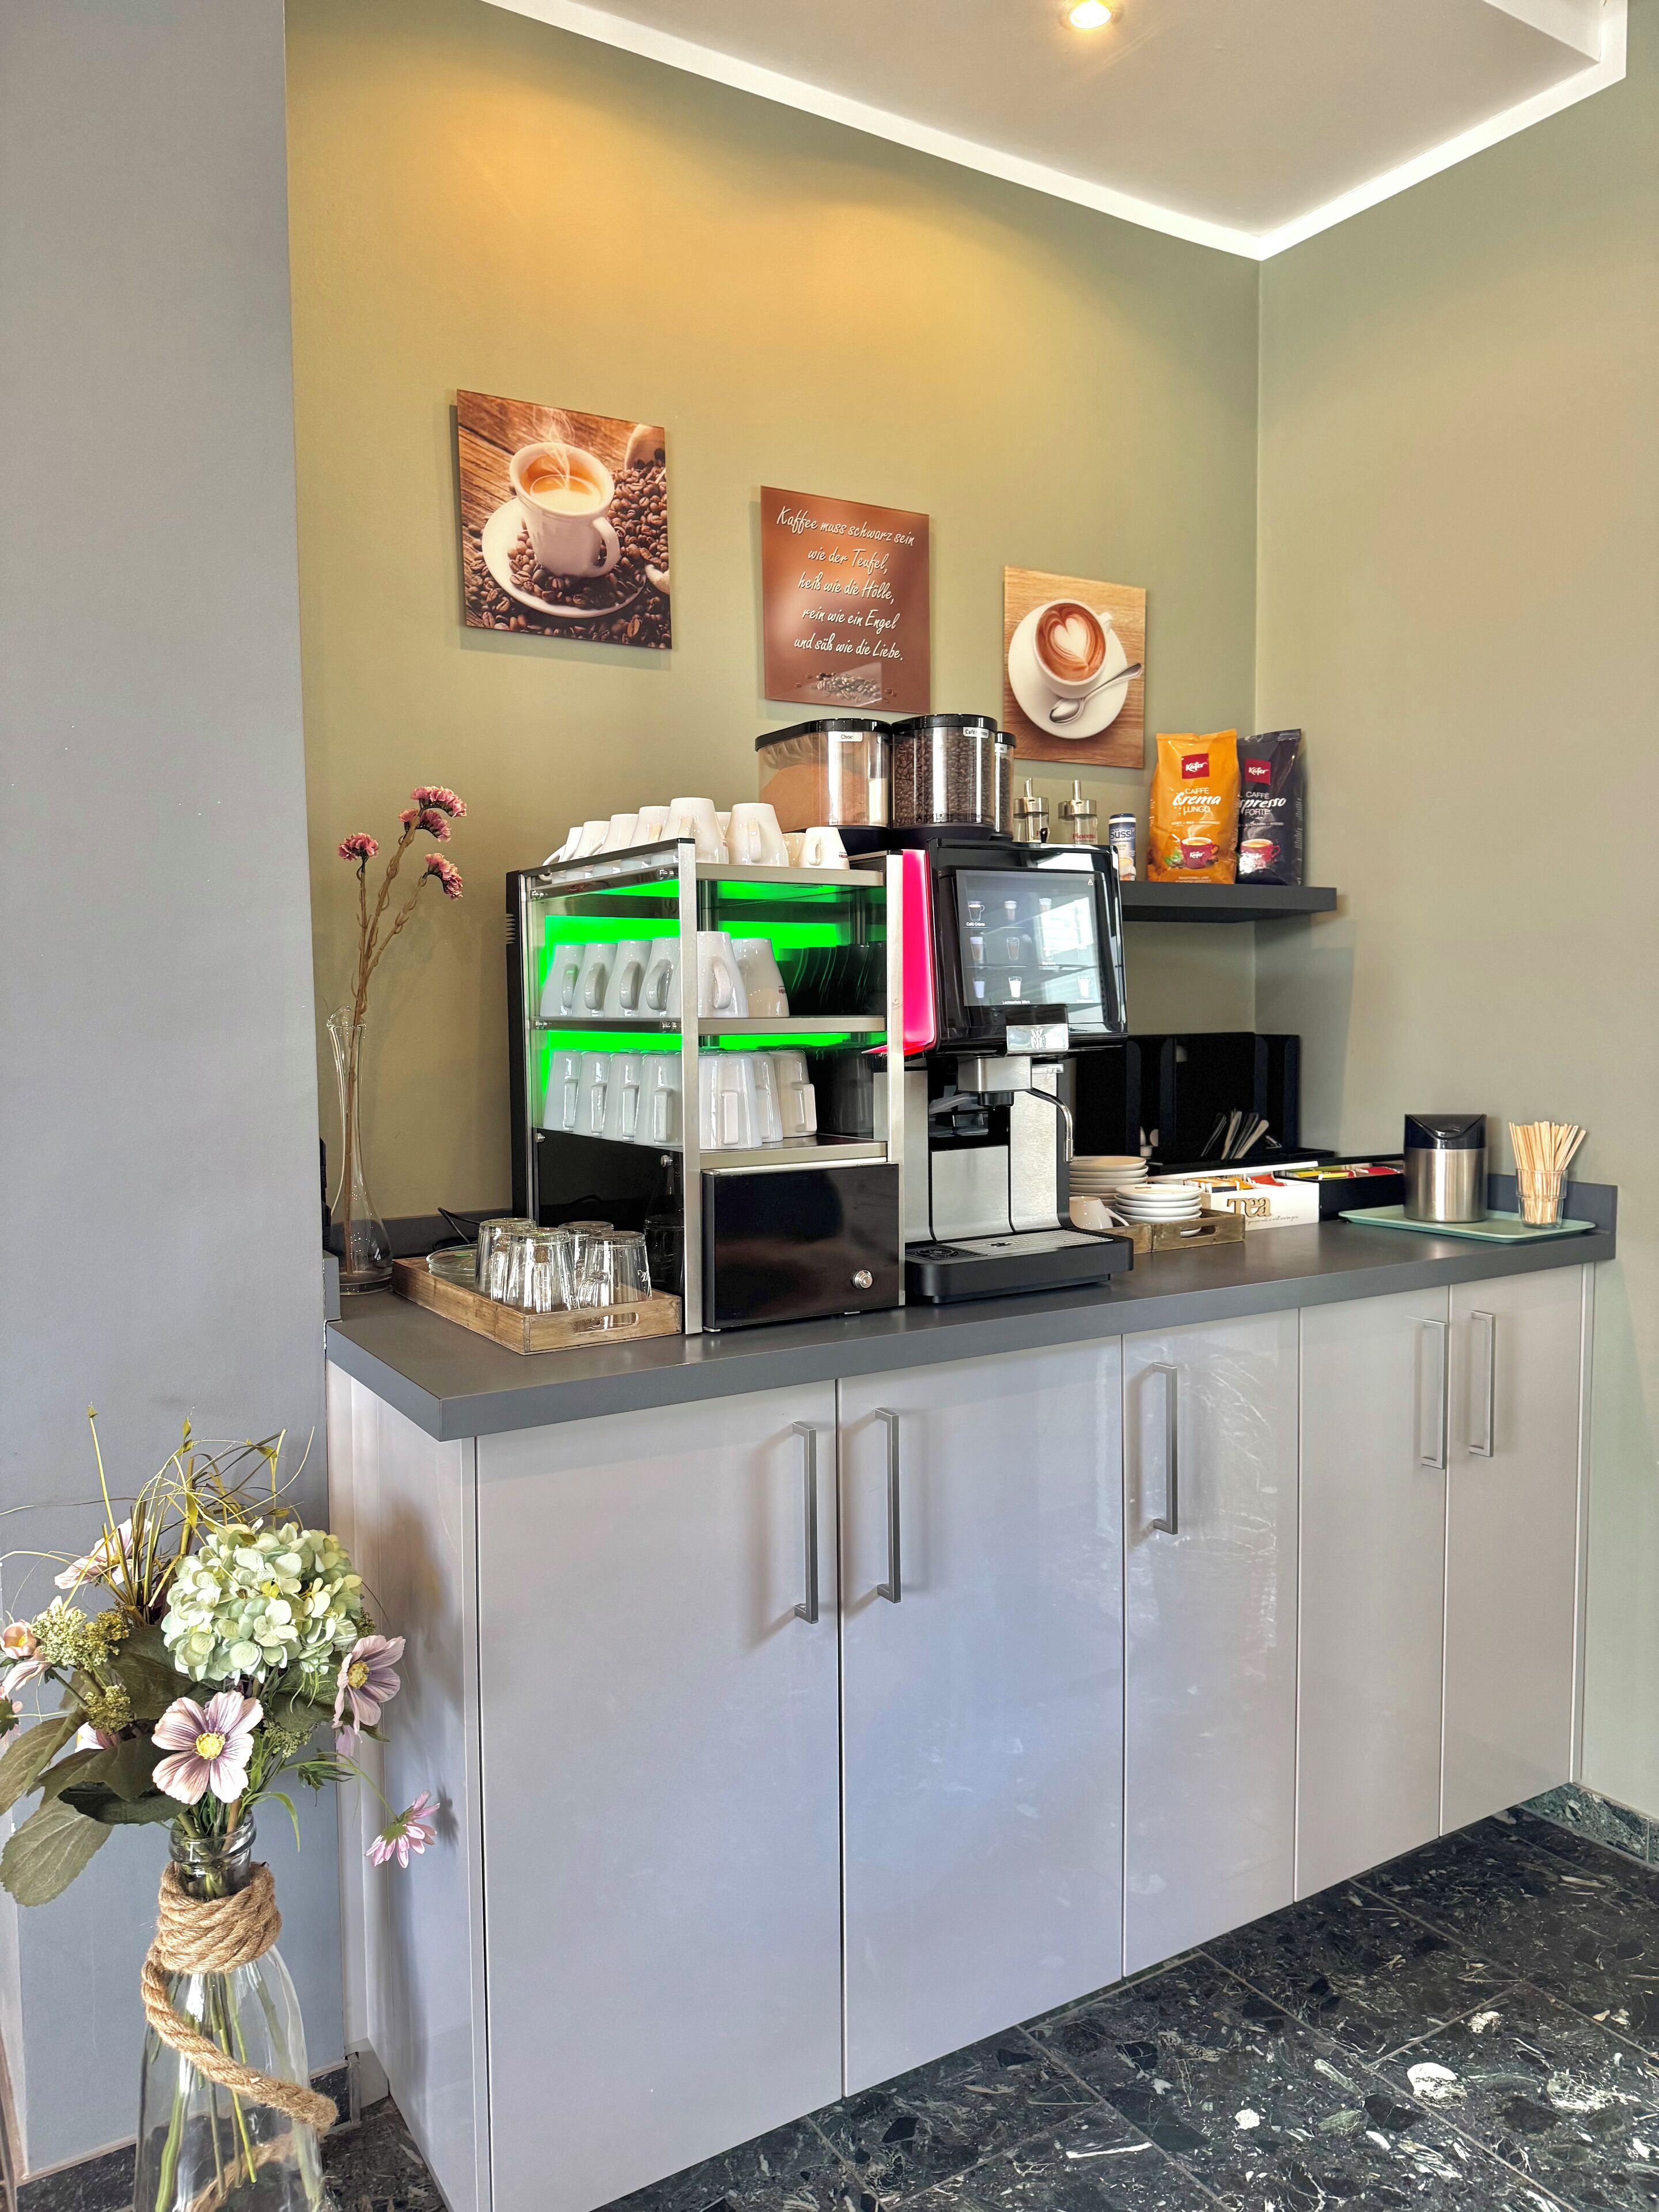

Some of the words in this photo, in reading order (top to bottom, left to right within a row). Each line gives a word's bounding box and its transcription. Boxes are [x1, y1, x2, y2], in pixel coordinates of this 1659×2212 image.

[777, 506, 818, 535] Kaffee
[820, 521, 847, 535] muss
[848, 521, 893, 541] schwarz
[894, 532, 915, 546] sein
[808, 547, 827, 561] wie
[828, 546, 849, 565] der
[852, 548, 889, 575] Teufel,
[798, 571, 824, 591] heiß
[824, 579, 842, 593] wie
[844, 578, 860, 596] die
[861, 578, 894, 605] Hölle,
[801, 607, 825, 622] rein
[827, 609, 846, 623] wie
[847, 611, 863, 627] ein
[865, 609, 900, 635] Engel
[794, 632, 816, 649] und
[815, 632, 836, 651] süß
[835, 639, 854, 653] wie
[855, 639, 871, 655] die
[872, 640, 903, 660] Liebe.
[1172, 791, 1221, 806] Crema
[1183, 805, 1211, 813] LUNGO
[1238, 798, 1287, 815] spresso
[1227, 1197, 1272, 1218] Tea
